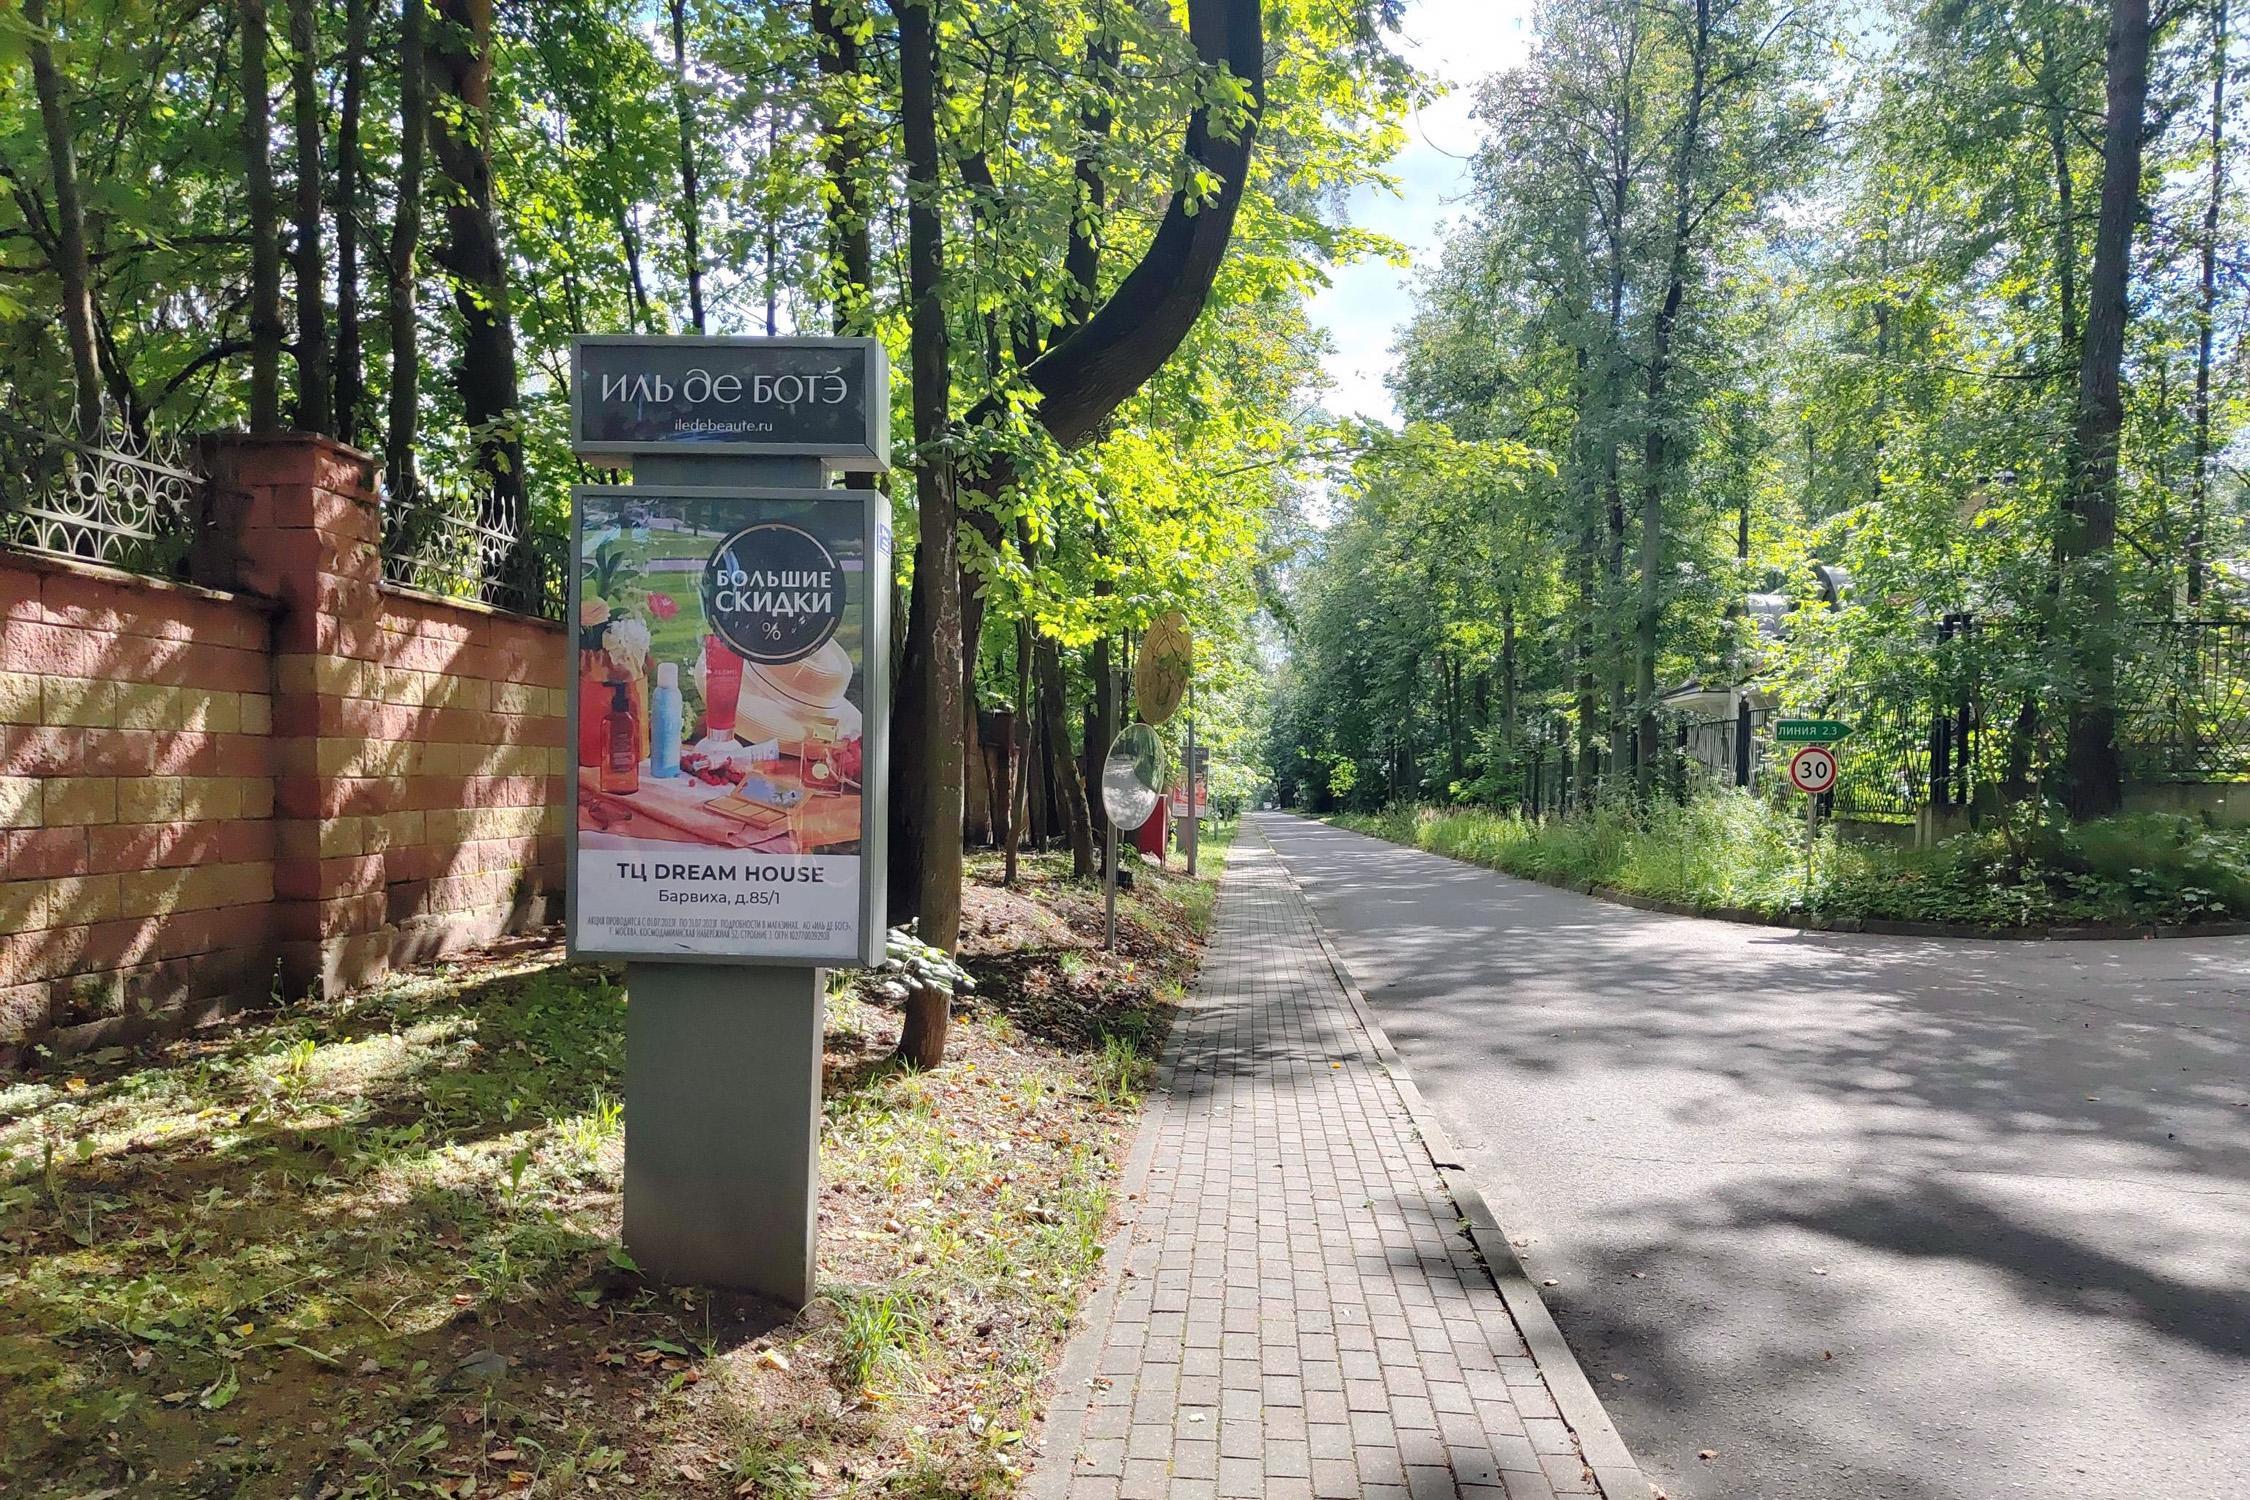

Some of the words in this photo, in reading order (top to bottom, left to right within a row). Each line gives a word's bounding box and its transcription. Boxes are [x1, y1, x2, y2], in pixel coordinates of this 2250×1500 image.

[601, 374, 674, 402] ИЛЬ
[674, 418, 773, 432] iledebeaute.ru
[716, 569, 832, 588] БОЛЬШИЕ
[715, 591, 832, 617] СКИДКИ
[762, 622, 781, 641] %
[1777, 726, 1817, 736] ЛИНИЯ
[1801, 761, 1827, 778] 30
[617, 862, 647, 882] ТЦ
[654, 864, 736, 882] DREAM
[745, 866, 824, 883] HOUSE
[660, 890, 730, 905] Барвиха,
[735, 890, 780, 905] д.85/1
